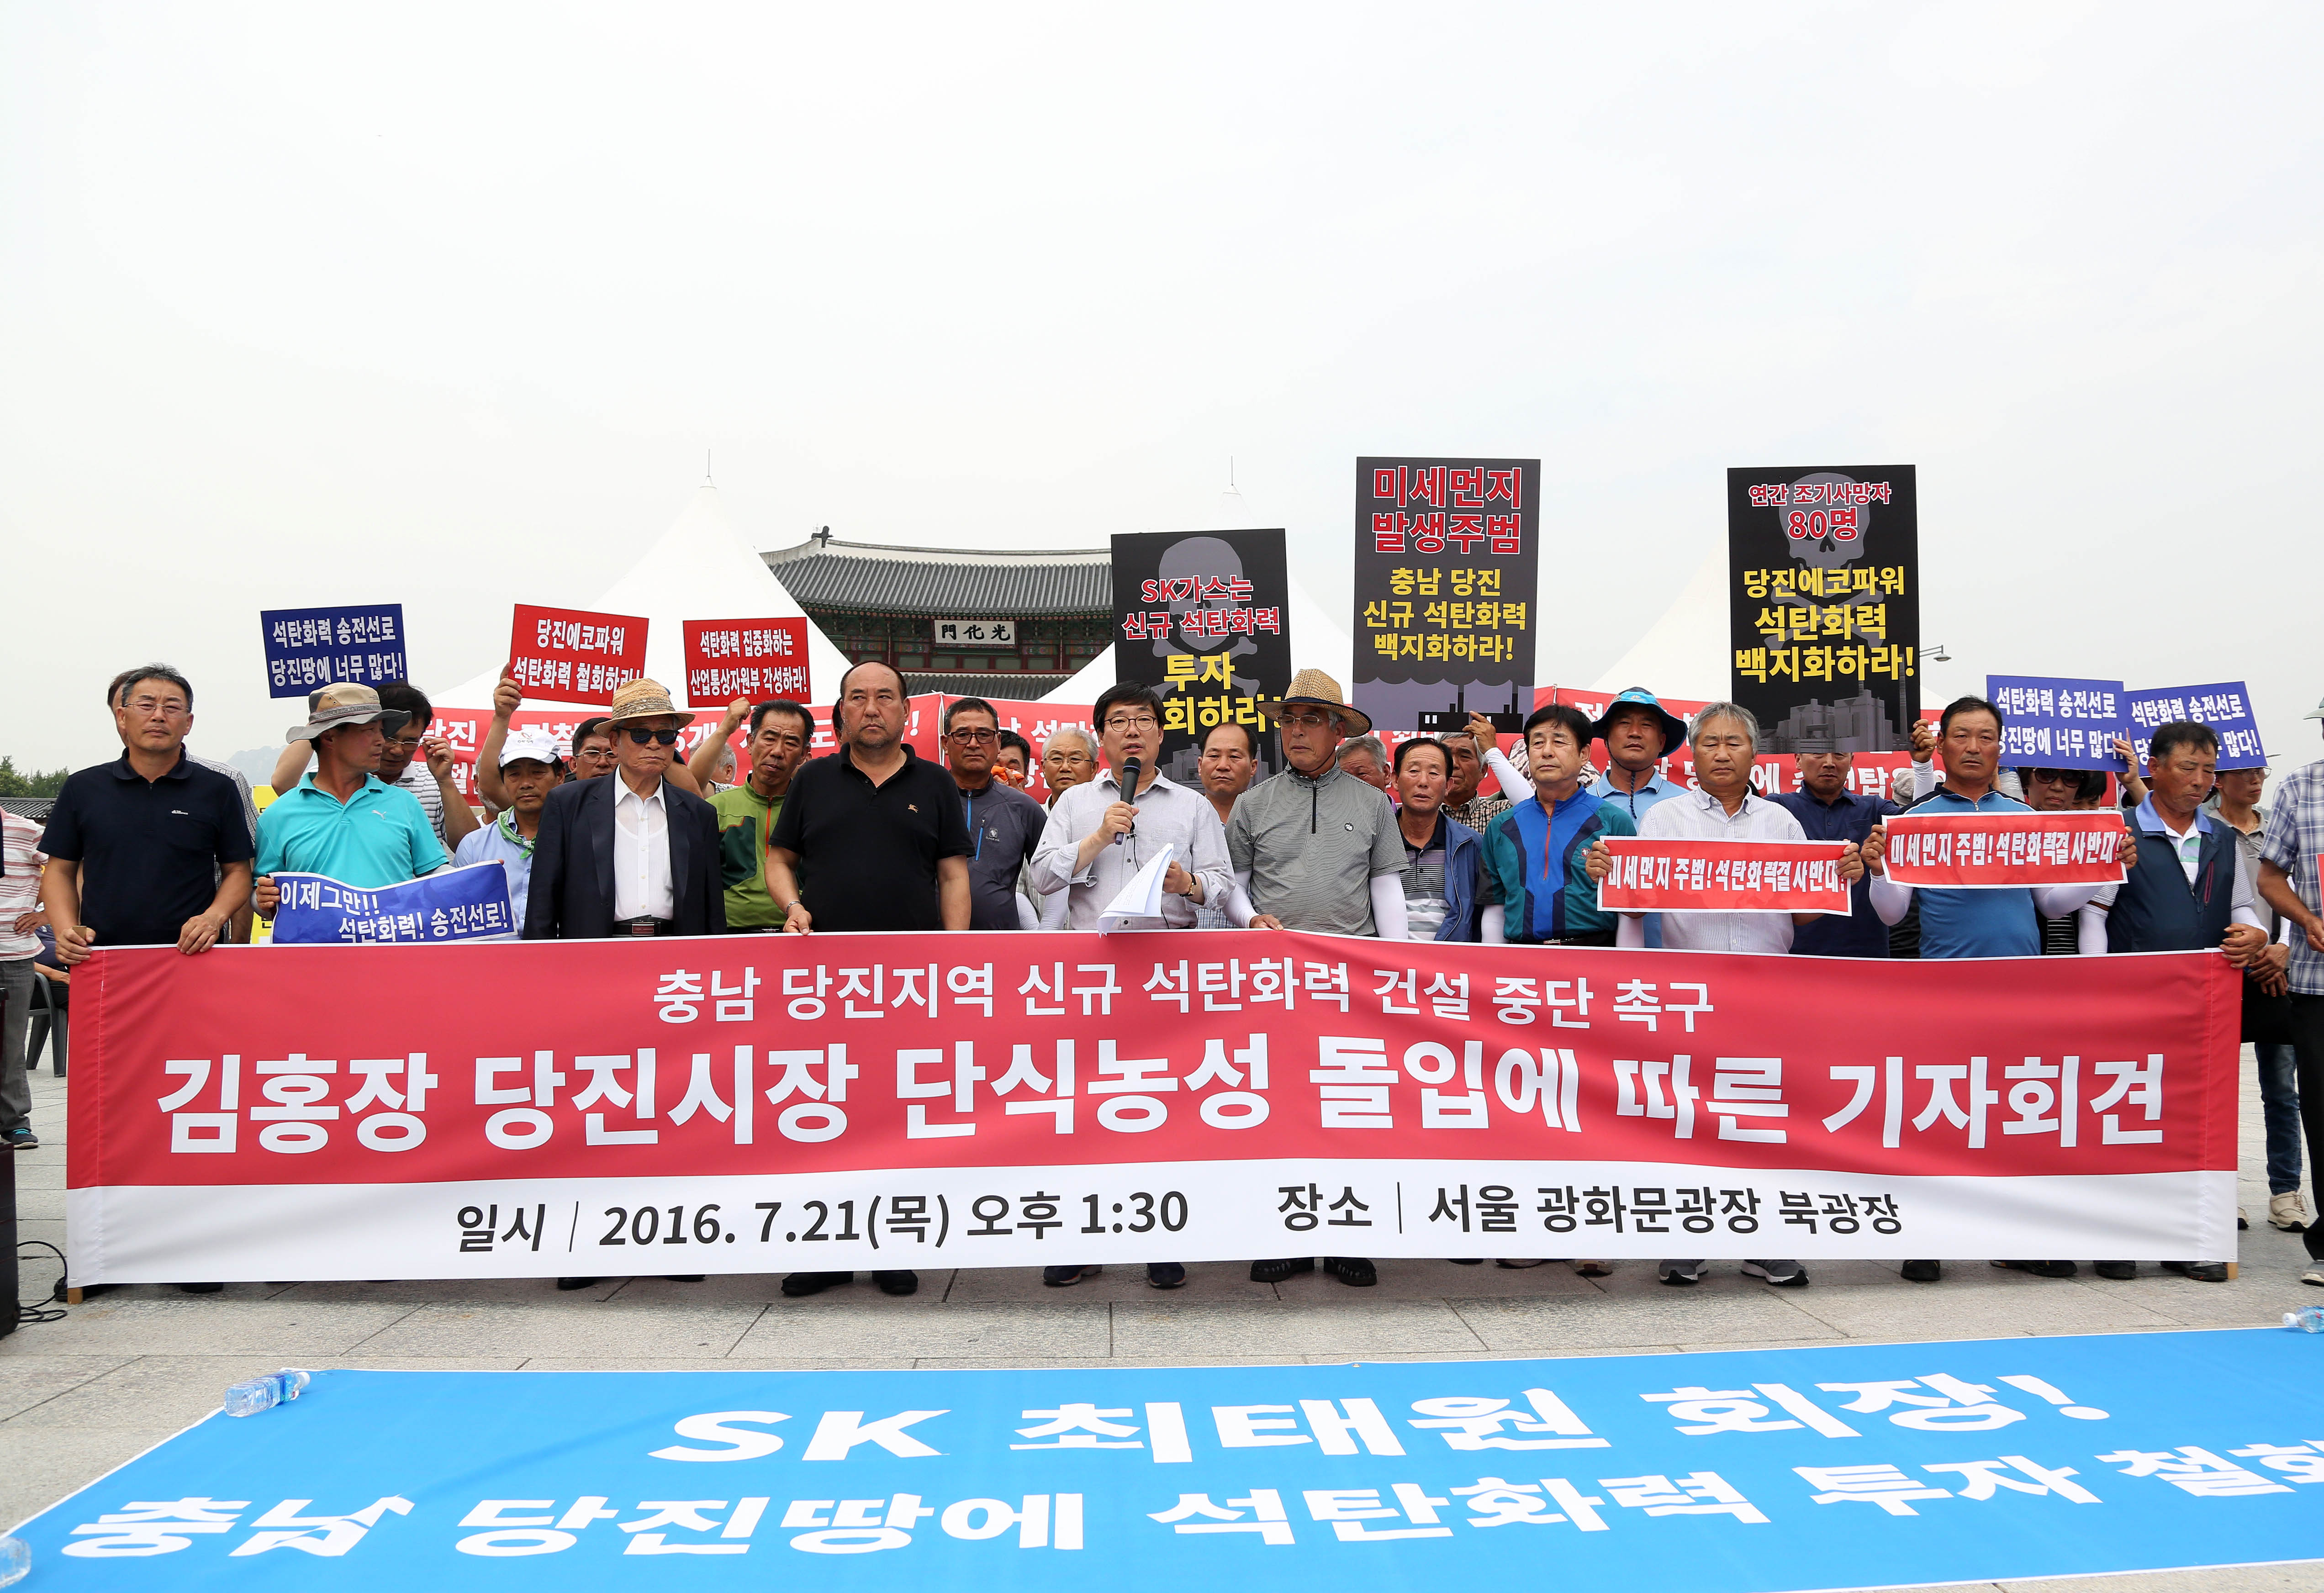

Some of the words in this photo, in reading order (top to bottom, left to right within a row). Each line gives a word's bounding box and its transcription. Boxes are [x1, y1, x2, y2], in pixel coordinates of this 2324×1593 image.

[1374, 466, 1521, 509] 미세먼지
[1748, 484, 1789, 506] 연간
[1793, 482, 1891, 505] 조기사망자
[1372, 512, 1521, 554] 발생주범
[1788, 506, 1858, 541] 80명
[1141, 575, 1253, 603] SK가스는
[1391, 568, 1442, 595] 충남
[1452, 569, 1500, 596] 당진
[1745, 566, 1904, 597] 당진에코파워
[1121, 612, 1173, 640] 신규
[1179, 607, 1279, 637] 석탄화력
[1364, 600, 1414, 627] 신규
[1424, 601, 1526, 629] 석탄화력
[1755, 604, 1886, 640] 석탄화력
[273, 619, 332, 648] 석탄화력
[337, 616, 395, 644] 송전선로
[538, 619, 624, 655] 당진에코파워
[700, 630, 739, 658] 석탄화력
[743, 629, 792, 657] 집중화하는
[1375, 634, 1513, 662] 백지화하라!
[271, 656, 330, 687] 당진땅에
[336, 655, 364, 681] 너무
[369, 653, 403, 680] 많다!
[513, 657, 571, 690] 석탄화력
[1165, 652, 1235, 691] 투자
[1737, 644, 1914, 682] 백지화하라!
[691, 668, 760, 696] 산업통상자원부
[763, 666, 807, 693] 각성하라!
[1997, 687, 2054, 717] 석탄화력
[2059, 690, 2117, 718] 송전선로
[2132, 698, 2187, 727] 석탄화력
[2189, 694, 2245, 723] 송전선로
[2056, 728, 2085, 757] 너무
[2223, 729, 2261, 756] 많다!
[1891, 833, 1952, 866] 미세먼지
[1956, 833, 1993, 866] 주범!
[1608, 855, 1670, 890] 미세먼지
[1674, 859, 1712, 890] 주범!
[281, 881, 380, 916] 이제그만!!
[338, 912, 424, 943] 석탄화력!
[431, 901, 508, 937] 송전선로!
[654, 967, 761, 1023] 충남
[783, 963, 993, 1020] 당진지역
[1018, 962, 1121, 1015] 신규
[1142, 957, 1348, 1013] 석탄화력
[1373, 969, 1470, 1021] 건설
[1493, 977, 1593, 1029] 중단
[1613, 979, 1713, 1032] 촉구
[158, 1053, 438, 1153] 김홍장
[475, 1044, 858, 1150] 당진시장
[897, 1033, 1269, 1139] 단식농성
[1310, 1036, 1582, 1132] 돌입에
[1613, 1055, 1788, 1143] 따른
[1822, 1054, 2163, 1148] 기자회견
[458, 1204, 545, 1252] 일시
[600, 1204, 735, 1245] 2016.
[755, 1194, 949, 1249] 7.21(목)
[967, 1192, 1062, 1239] 오후
[1082, 1192, 1188, 1233] 1:30
[1278, 1183, 1372, 1231] 장소
[1429, 1185, 1518, 1232] 서울
[1537, 1186, 1760, 1233] 광화문광장
[1780, 1191, 1901, 1234] 북광장
[648, 1410, 951, 1461] SK
[1009, 1388, 1612, 1463] 최태원
[1639, 1373, 2110, 1438] 회장!
[62, 1495, 415, 1557] 충남
[455, 1493, 1083, 1556] 당진땅에
[1146, 1471, 1771, 1545] 석탄화력
[1792, 1456, 2102, 1516] 투자
